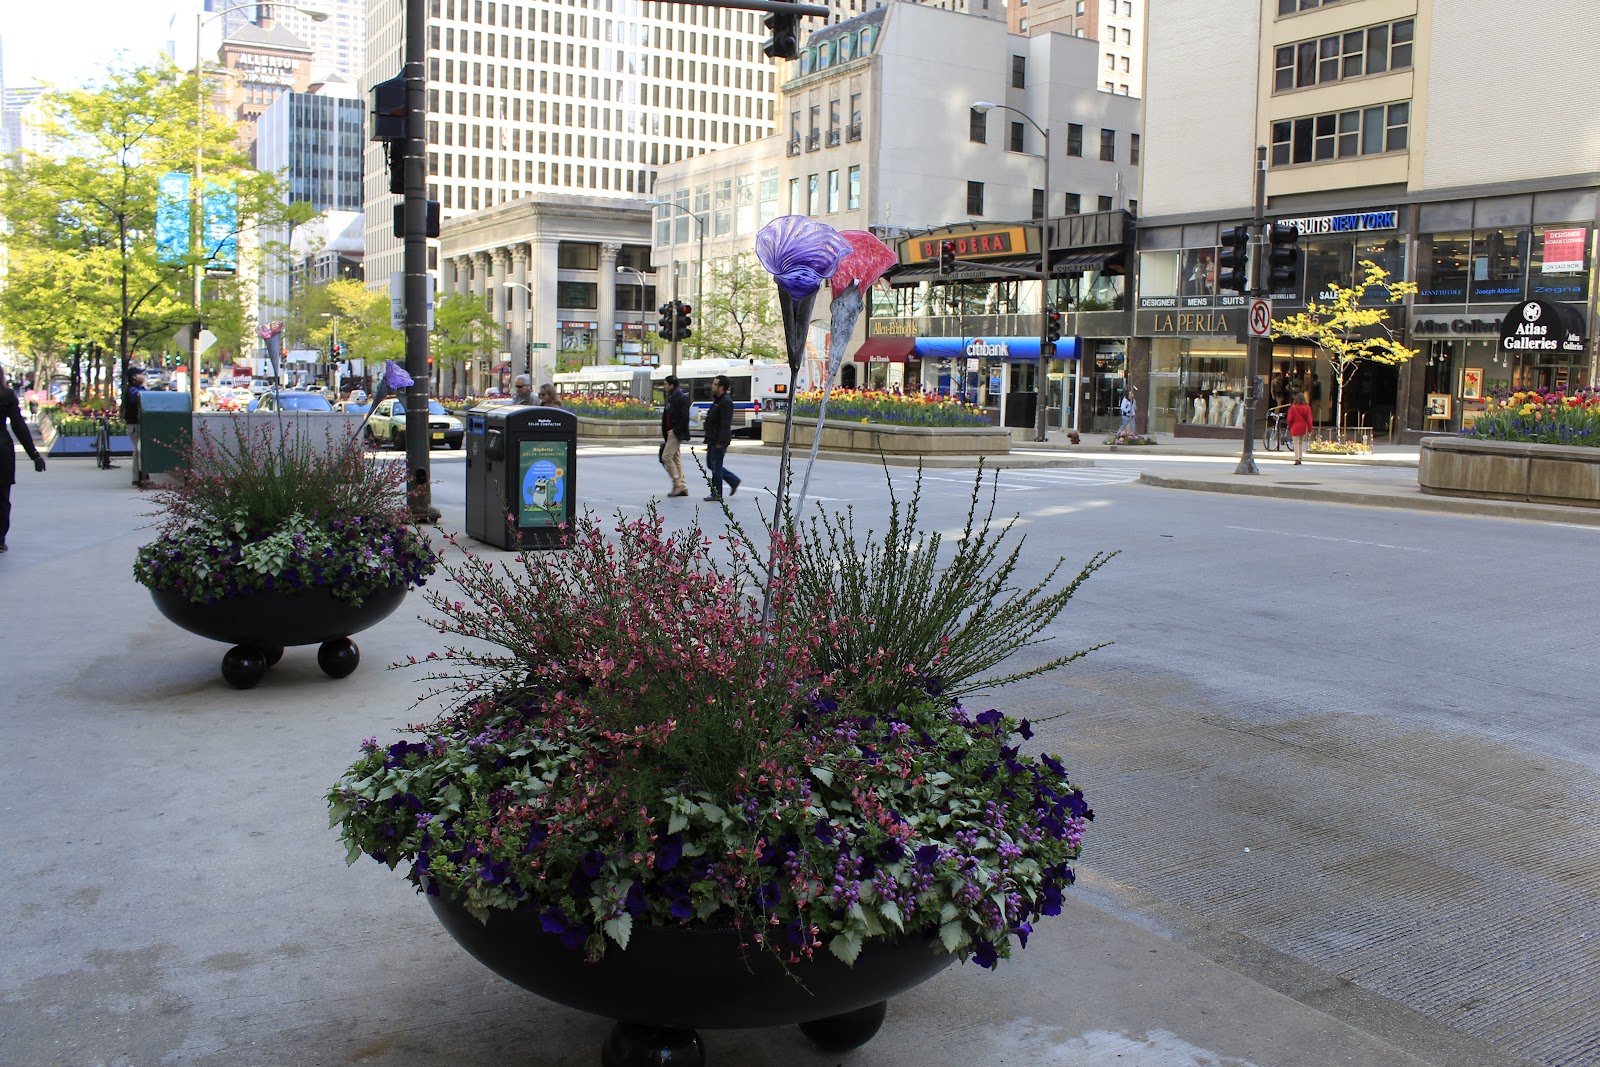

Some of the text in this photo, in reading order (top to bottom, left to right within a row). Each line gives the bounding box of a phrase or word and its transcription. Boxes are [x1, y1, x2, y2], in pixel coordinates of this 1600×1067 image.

[240, 53, 300, 69] ALLERTON
[254, 67, 286, 75] HOTEL
[1298, 217, 1331, 233] SUITS
[1331, 215, 1359, 231] NEW
[1360, 212, 1395, 229] YORK
[1056, 263, 1101, 272] COCKTAILS
[1142, 298, 1175, 306] DESIGNER
[1187, 298, 1208, 306] MENS
[1222, 296, 1245, 305] SUITS
[1153, 313, 1229, 332] LA PERLA
[1413, 318, 1503, 334] Atlas Galleri
[1515, 322, 1547, 335] Atlas
[1567, 333, 1580, 342] Atlas
[967, 340, 1009, 356] citibank
[1503, 337, 1558, 350] Galleries
[1562, 341, 1584, 351] Galleries
